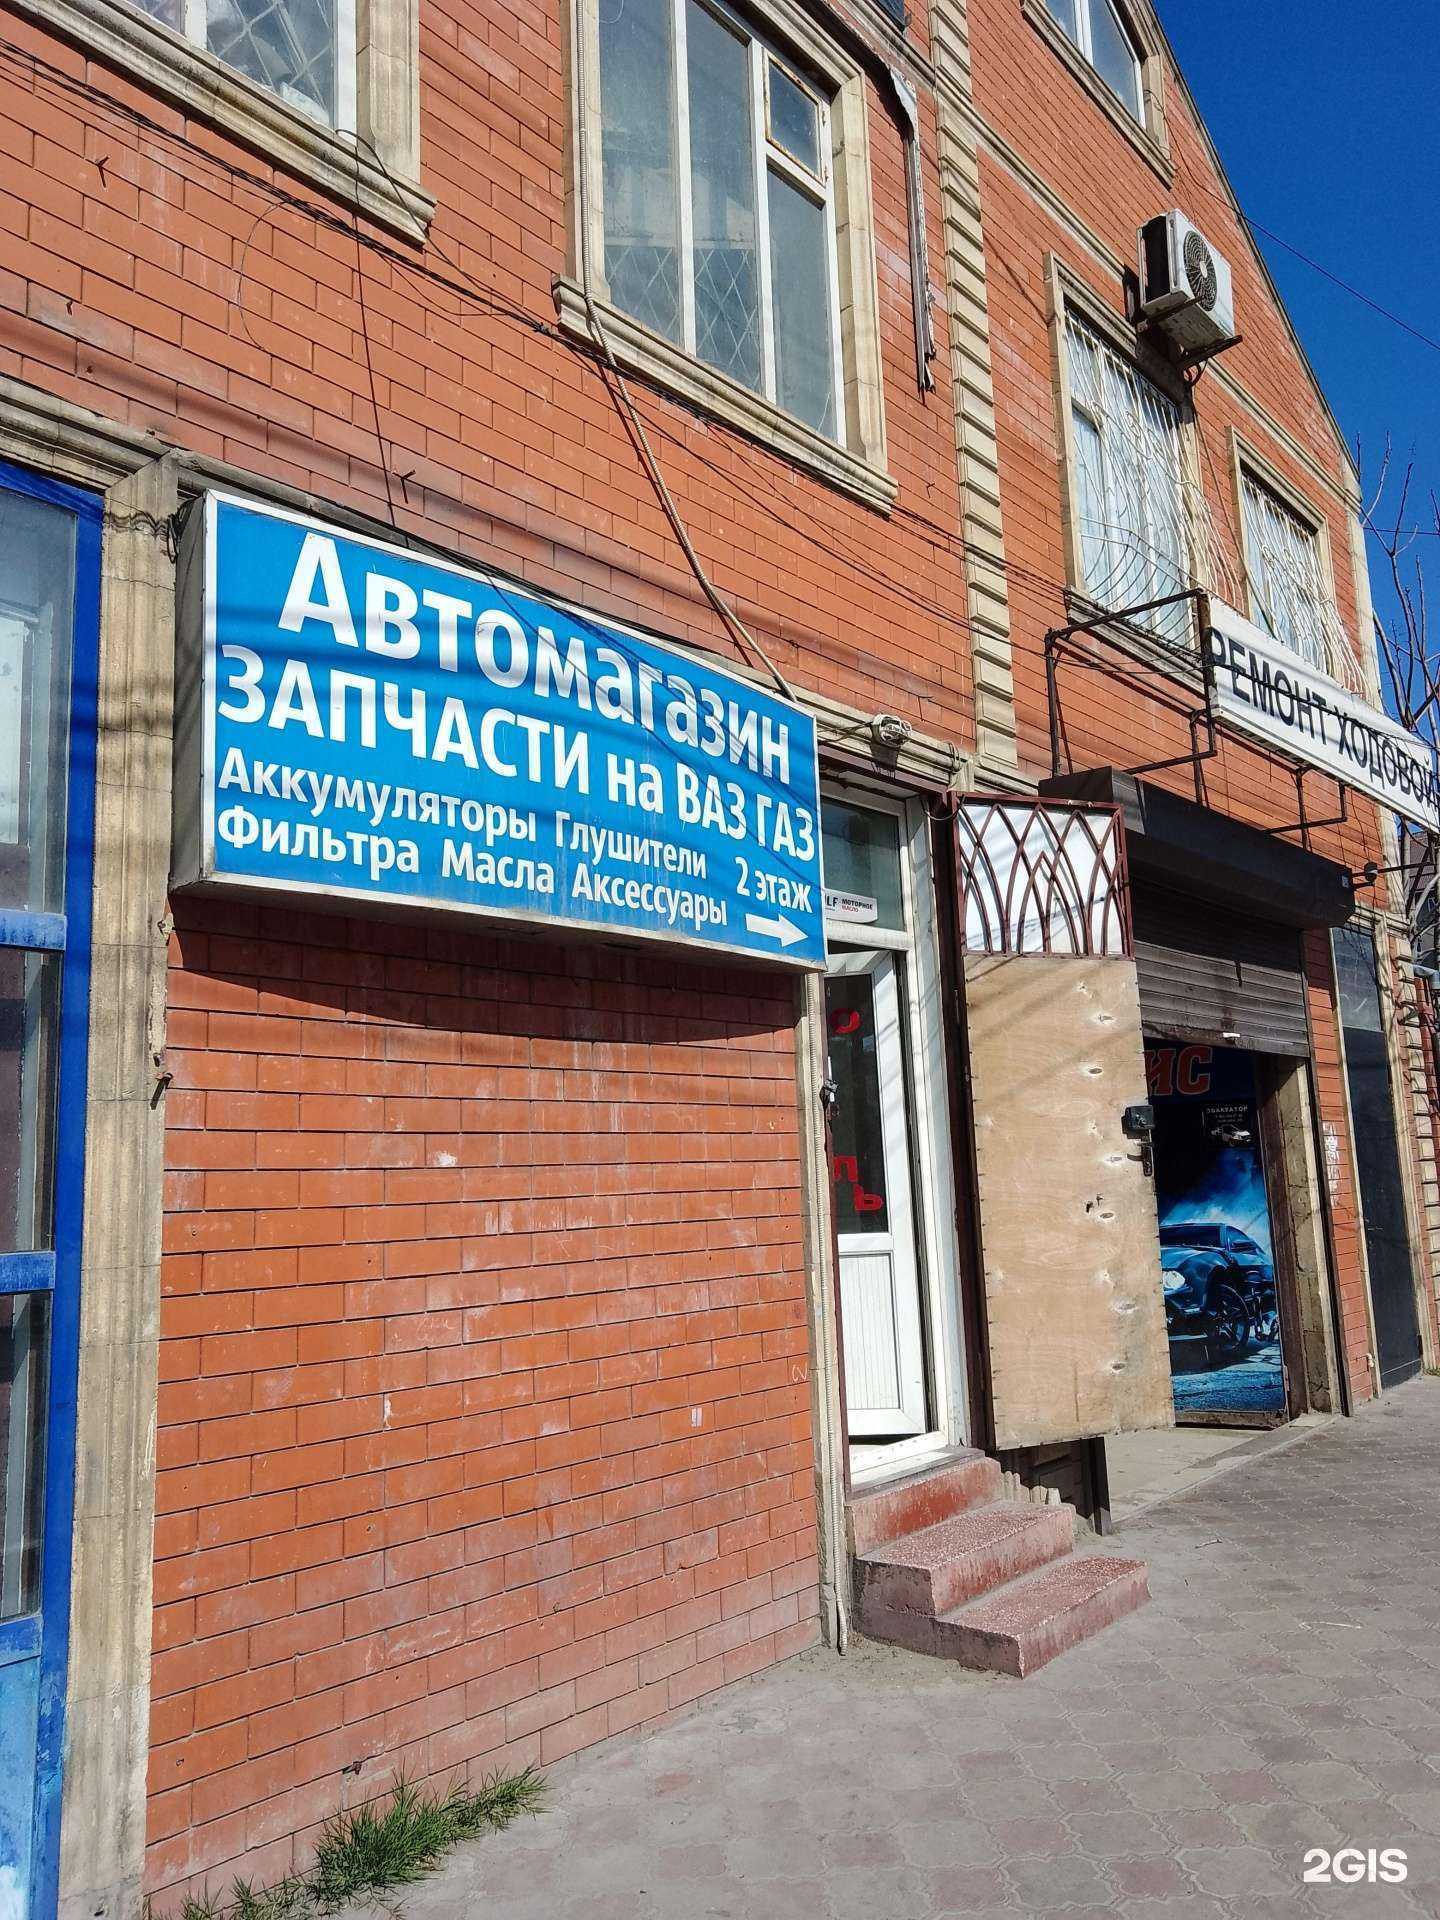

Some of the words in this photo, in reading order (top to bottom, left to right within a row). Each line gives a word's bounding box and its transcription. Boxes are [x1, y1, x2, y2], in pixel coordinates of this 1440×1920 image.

[278, 532, 791, 785] Автомагазин
[1206, 626, 1327, 745] РЕМОНТ
[1334, 704, 1438, 812] ХОДОВОЙ
[217, 644, 590, 796] ЗАПЧАСТИ
[607, 752, 664, 815] на
[676, 762, 747, 840] ВАЗ
[757, 793, 815, 862] ГАЗ
[217, 747, 537, 842] Аккумуляторы
[555, 810, 708, 880] Глушители
[217, 805, 421, 882] Фильтра
[441, 838, 556, 894] Масла
[571, 862, 729, 932] Аксессуары
[735, 856, 750, 898] 2
[754, 870, 814, 914] этаж
[841, 898, 873, 911] МОТОРНОЕ
